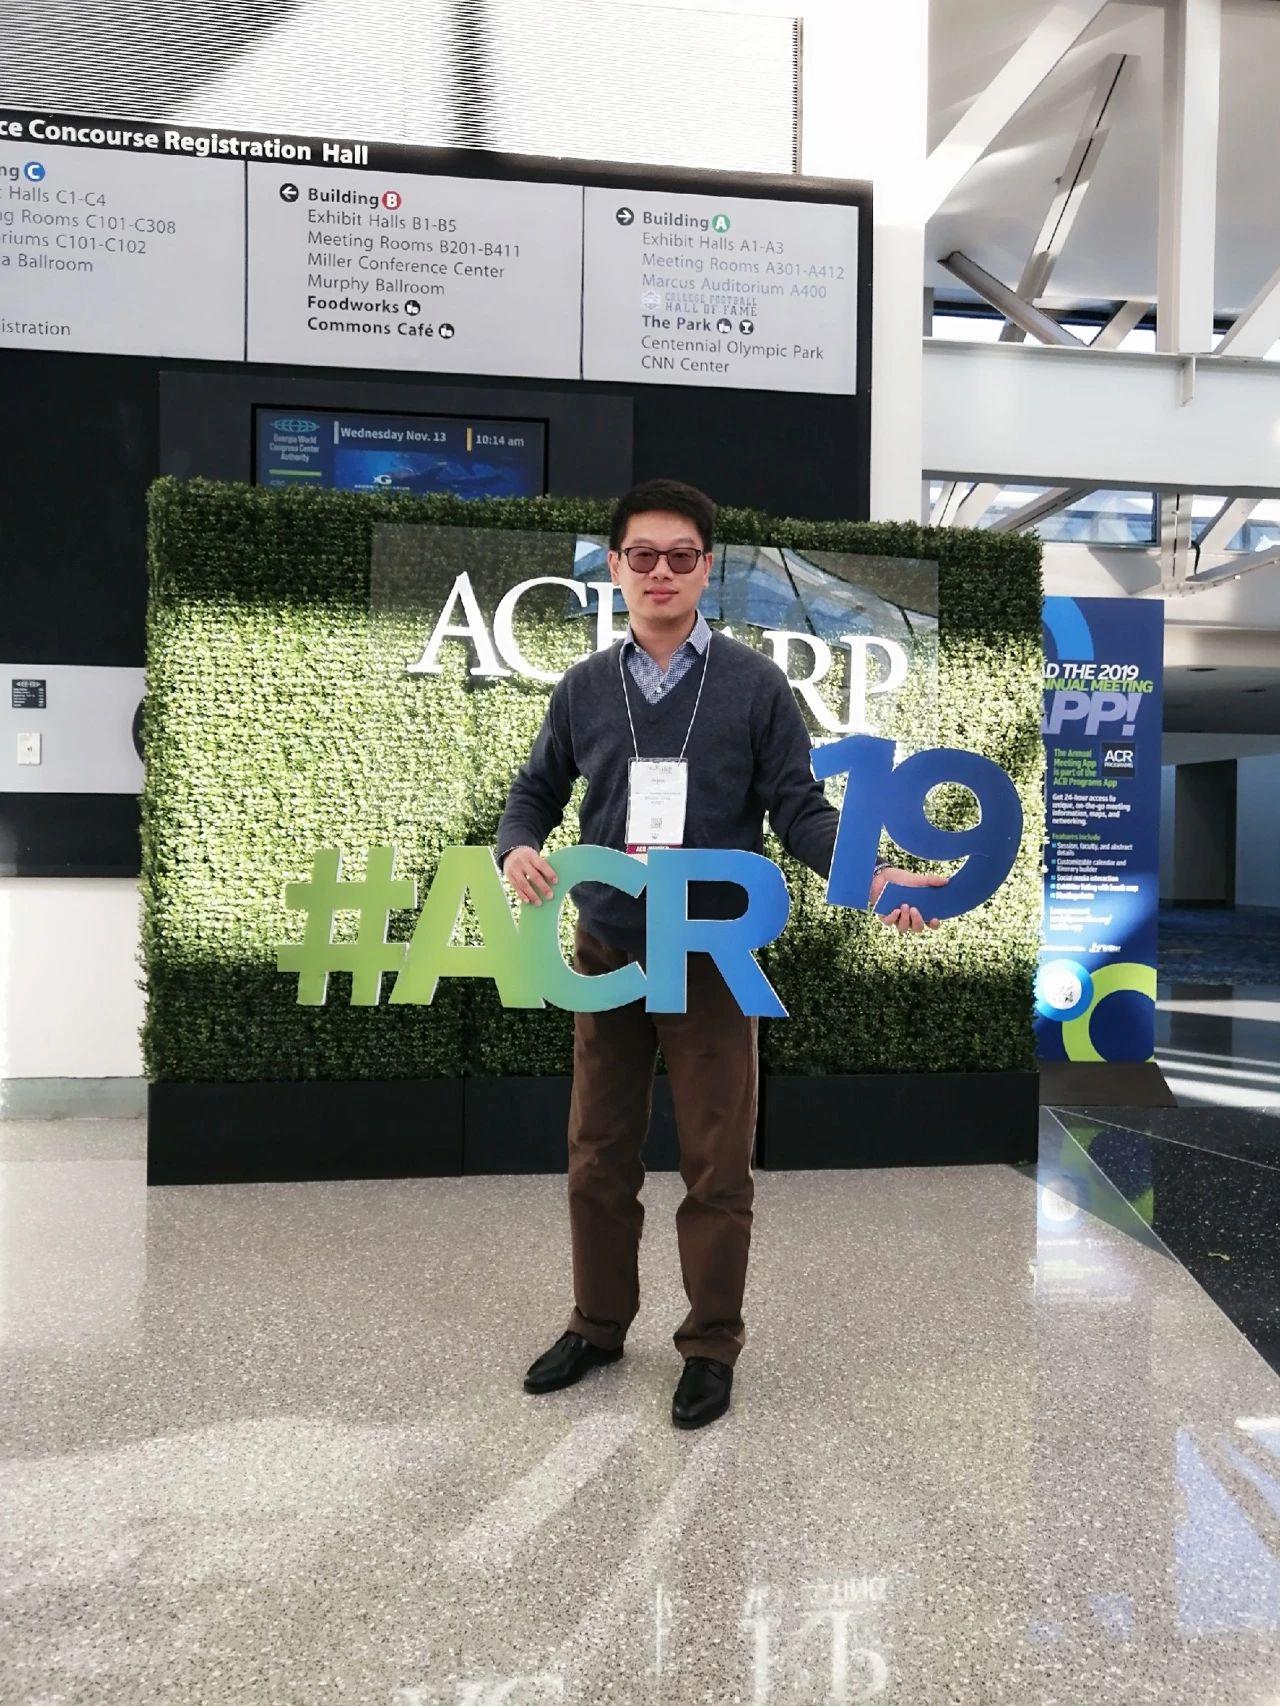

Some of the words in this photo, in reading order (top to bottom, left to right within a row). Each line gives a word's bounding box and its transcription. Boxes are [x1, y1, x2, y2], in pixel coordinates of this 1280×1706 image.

[28, 119, 159, 148] Concourse
[164, 130, 311, 161] Registration
[323, 142, 369, 165] Hall
[9, 186, 49, 203] Halls
[56, 189, 106, 207] C1-C4
[308, 188, 379, 209] Building
[21, 209, 79, 227] Rooms
[86, 214, 176, 234] C101-C308
[308, 209, 362, 227] Exhibit
[369, 214, 406, 230] Halls
[412, 217, 457, 233] B1-B5
[643, 211, 709, 231] Building
[56, 234, 147, 254] C101-C102
[308, 231, 373, 251] Meeting
[380, 235, 433, 253] Rooms
[440, 240, 520, 257] B201-B411
[643, 232, 693, 248] Exhibit
[700, 236, 734, 251] Halls
[740, 240, 784, 255] A1-A3
[18, 253, 93, 273] Ballroom
[308, 252, 352, 268] Miller
[358, 256, 447, 275] Conference
[454, 262, 505, 278] Center
[642, 253, 703, 272] Meeting
[710, 257, 759, 274] Rooms
[766, 262, 845, 280] A301-A412
[308, 274, 369, 294] Murphy
[376, 278, 445, 295] Ballroom
[642, 274, 695, 290] Marcus
[701, 278, 784, 296] Auditorium
[790, 284, 827, 299] A400
[308, 296, 399, 314] Foodworks
[665, 292, 705, 304] COLLEGE
[709, 295, 758, 307] FOOTBALL
[665, 302, 698, 314] HALL
[703, 303, 717, 315] OF
[723, 305, 758, 317] FAME
[307, 317, 391, 335] Commons
[397, 323, 433, 337] Café
[642, 315, 671, 330] The
[677, 317, 712, 332] Park
[641, 335, 721, 353] Centennial
[727, 340, 788, 359] Olympic
[793, 344, 824, 360] Park
[641, 355, 674, 371] CNN
[681, 358, 730, 374] Center
[298, 435, 317, 444] World
[341, 426, 404, 442] Wednesday
[406, 430, 431, 443] Nov.
[433, 432, 447, 443] 13
[476, 434, 505, 446] 10:14
[507, 437, 525, 447] am
[720, 625, 909, 735] RP
[1062, 663, 1098, 680] THE
[1098, 664, 1139, 681] 2019
[1091, 679, 1153, 694] MEETING
[1054, 748, 1066, 757] The
[1067, 749, 1092, 757] Annual
[1104, 749, 1134, 762] ACR
[1053, 759, 1081, 769] Meeting
[1082, 759, 1097, 769] App
[1060, 769, 1076, 778] part
[1084, 769, 1097, 777] the
[1053, 777, 1068, 786] ACR
[1069, 778, 1102, 787] Programs
[1103, 779, 1118, 788] App
[1052, 793, 1064, 801] Get
[810, 734, 1023, 921] 19
[277, 844, 789, 1017] #ACR
